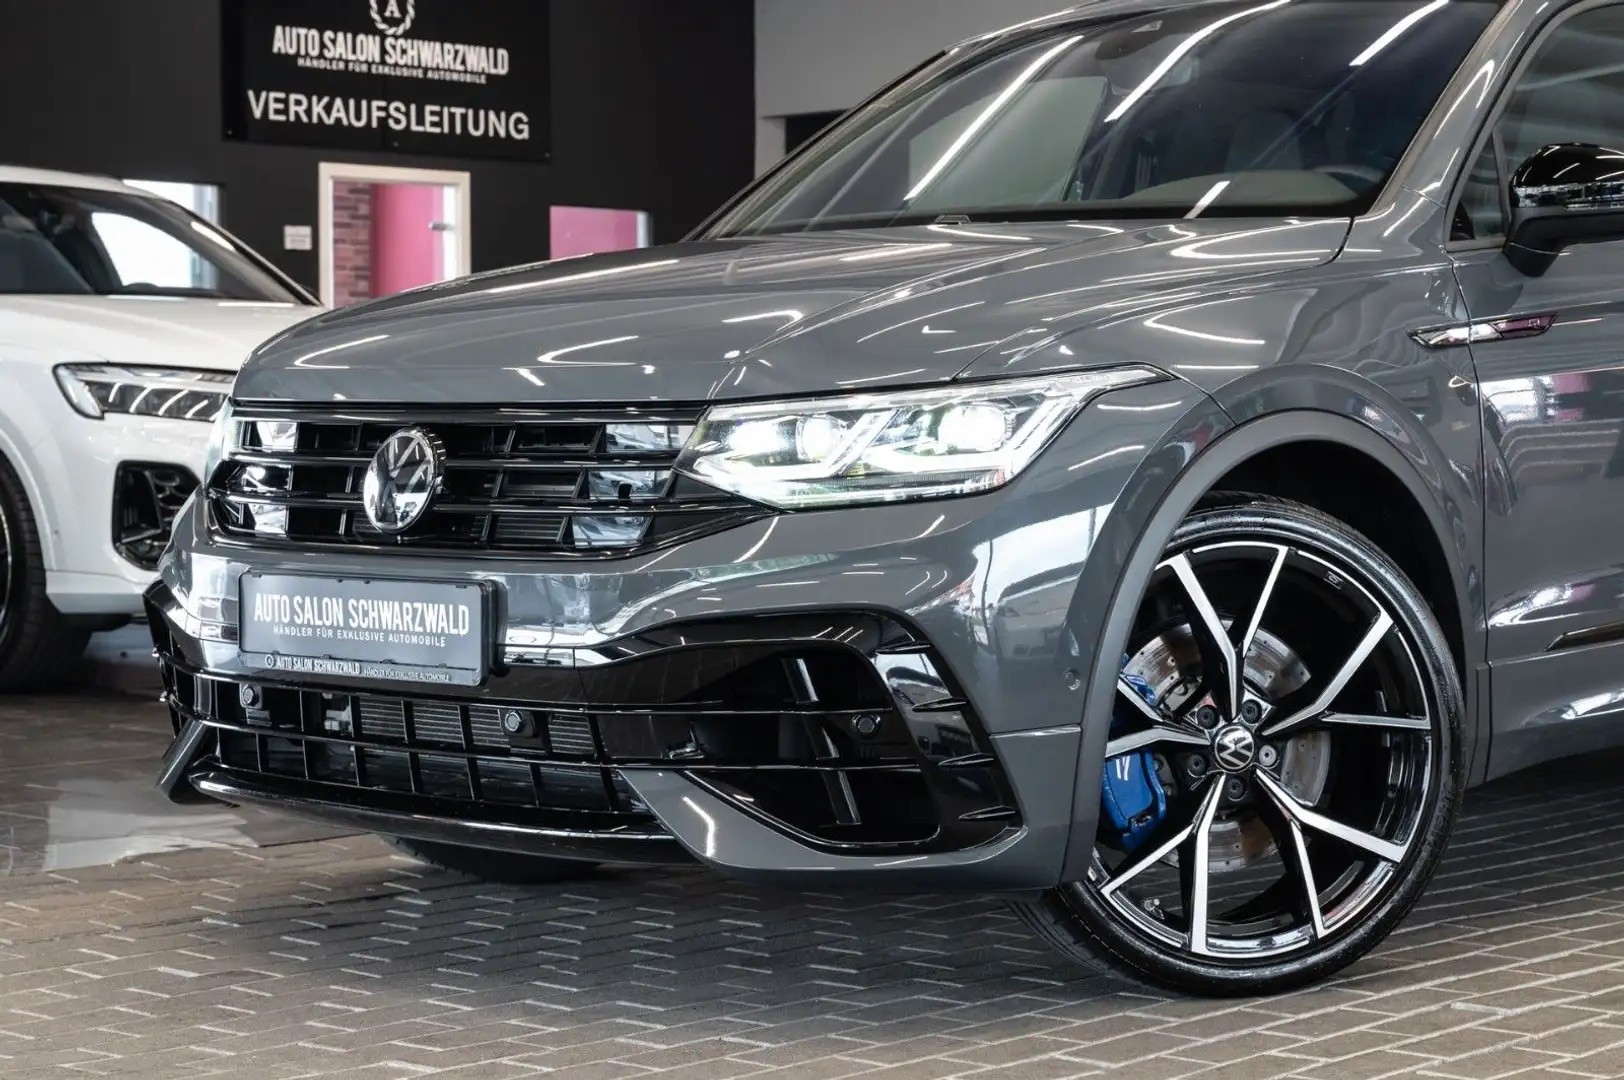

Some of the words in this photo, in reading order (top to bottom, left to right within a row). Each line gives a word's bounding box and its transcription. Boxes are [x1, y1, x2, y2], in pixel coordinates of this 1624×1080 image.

[272, 25, 320, 56] AUTO
[322, 30, 381, 63] SALON
[384, 37, 509, 75] SCHWARZWALD
[247, 89, 530, 140] VERKAUFSLEITUNG
[254, 592, 291, 623] AUTO
[293, 595, 344, 627] SALON
[348, 598, 470, 636] SCHWARZWALD
[273, 624, 313, 637] HÄNDLER
[316, 628, 334, 638] FÜR
[337, 629, 385, 642] EXKLUSIVE
[388, 633, 446, 648] AUTOMOBILE
[276, 655, 292, 669] AUTO
[293, 656, 314, 671] SALON
[314, 658, 361, 675] SCHWARZWALD
